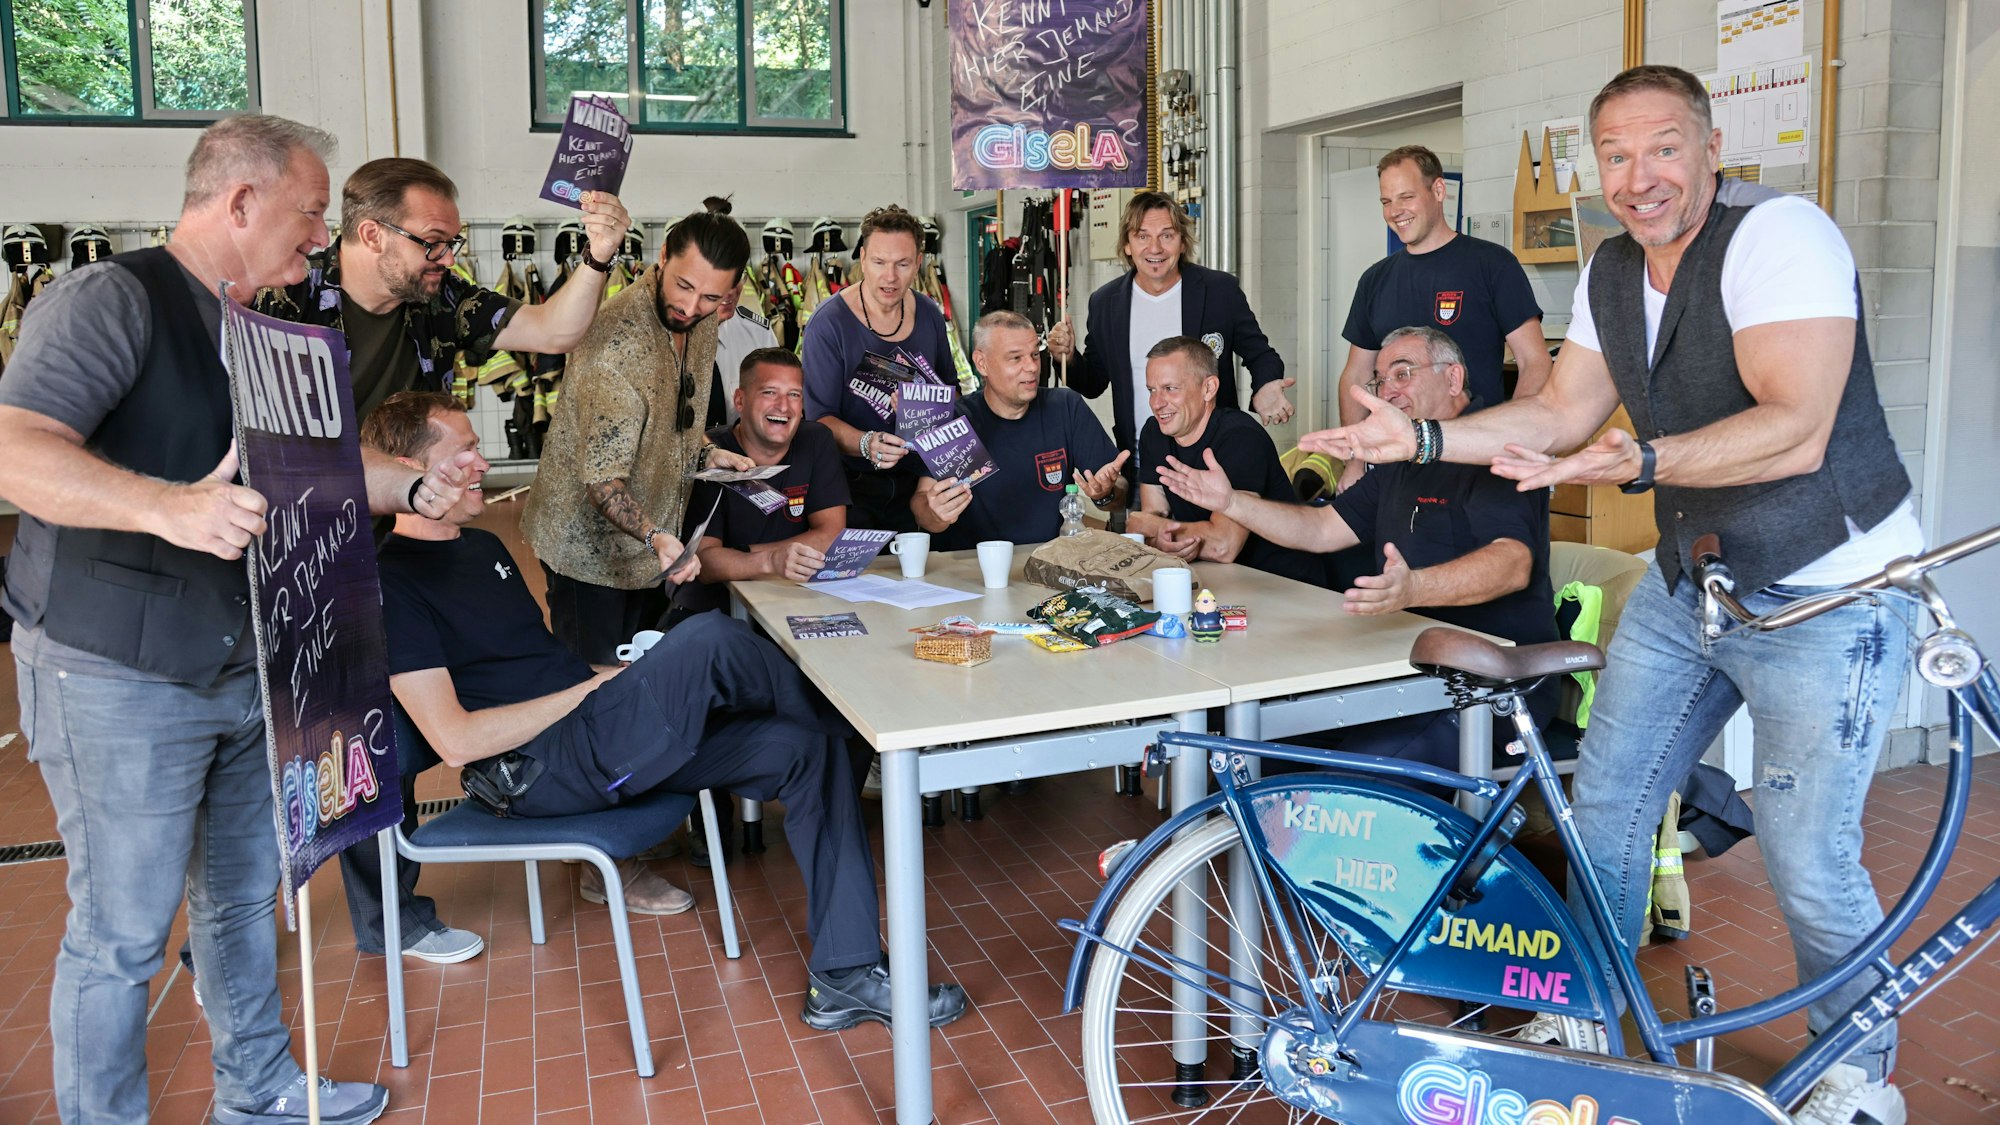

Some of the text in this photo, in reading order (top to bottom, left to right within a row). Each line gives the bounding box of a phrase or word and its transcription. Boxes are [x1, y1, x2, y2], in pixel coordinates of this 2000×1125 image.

[963, 0, 1134, 91] HIER JEMAND
[1020, 52, 1096, 112] EINE
[572, 100, 622, 139] WANTED
[559, 153, 585, 164] HIER
[569, 136, 604, 152] KENNT
[575, 166, 605, 181] EINE
[232, 311, 343, 439] WANTED
[849, 378, 893, 411] WANTED
[902, 383, 952, 404] WANTED
[899, 411, 950, 431] HIER JEMAND
[903, 408, 934, 419] KENNT
[916, 419, 970, 452] WANTED
[932, 445, 959, 467] KENNT
[936, 438, 977, 478] HIER JEMAND
[955, 456, 974, 478] EINE
[834, 545, 866, 555] KENNT
[841, 530, 893, 543] WANTED
[294, 498, 357, 629] JEMAND
[798, 630, 863, 640] WANTED
[291, 598, 338, 728] EINE
[1284, 800, 1377, 841] KENNT
[1335, 857, 1398, 893] HIER
[1428, 915, 1561, 960] JEMAND
[1501, 965, 1571, 1005] EINE
[1851, 916, 1981, 1032] GAZELLE
